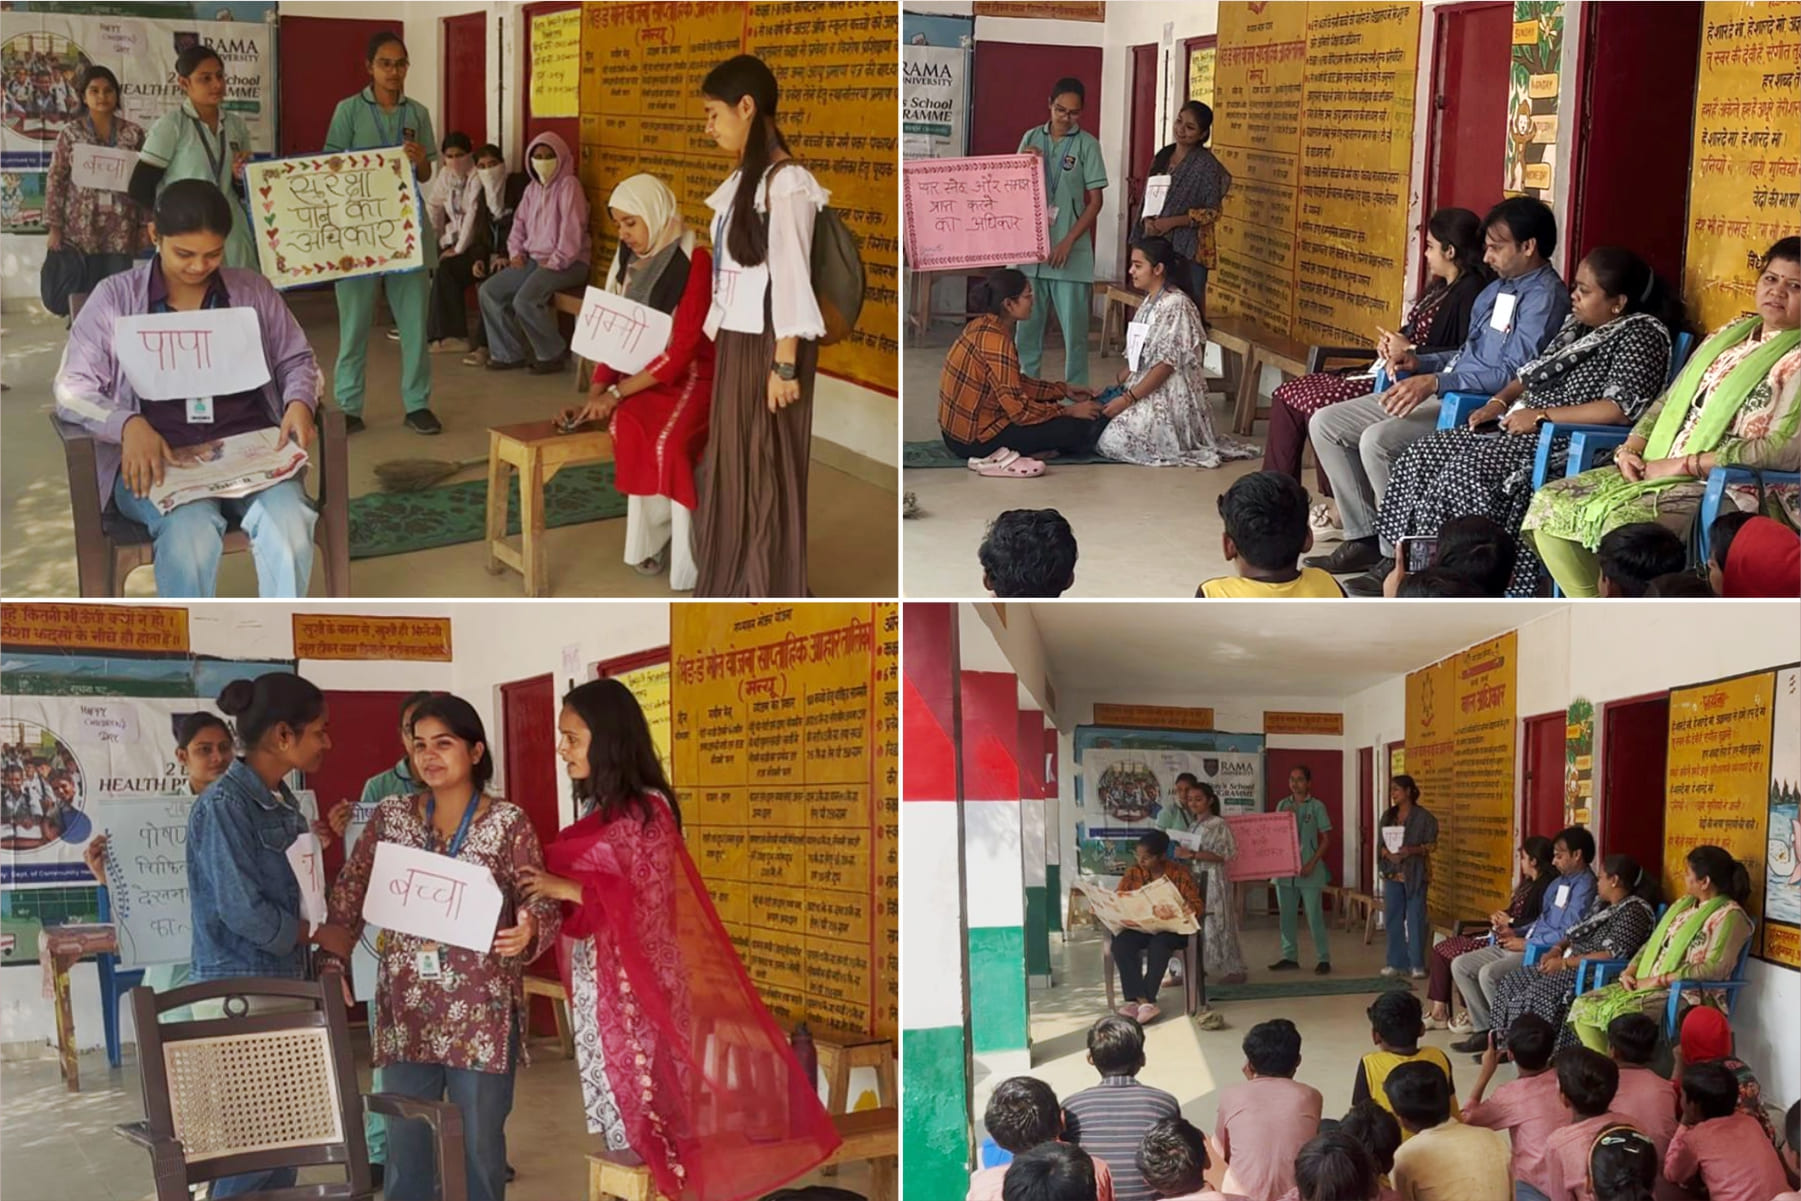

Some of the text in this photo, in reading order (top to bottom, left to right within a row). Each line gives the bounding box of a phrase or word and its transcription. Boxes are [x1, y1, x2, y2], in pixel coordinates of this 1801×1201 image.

[204, 37, 259, 55] RAMA
[226, 74, 260, 86] chool
[910, 97, 953, 110] School
[903, 108, 953, 122] RAMME
[83, 154, 126, 181] बच्चा
[287, 168, 376, 206] सुरक्षा
[344, 198, 387, 222] का
[934, 216, 961, 233] का
[136, 330, 213, 371] पापा
[165, 762, 176, 777] 2
[1221, 761, 1254, 772] RAMA
[98, 777, 166, 793] HEALTH
[388, 867, 468, 921] बच्चा
